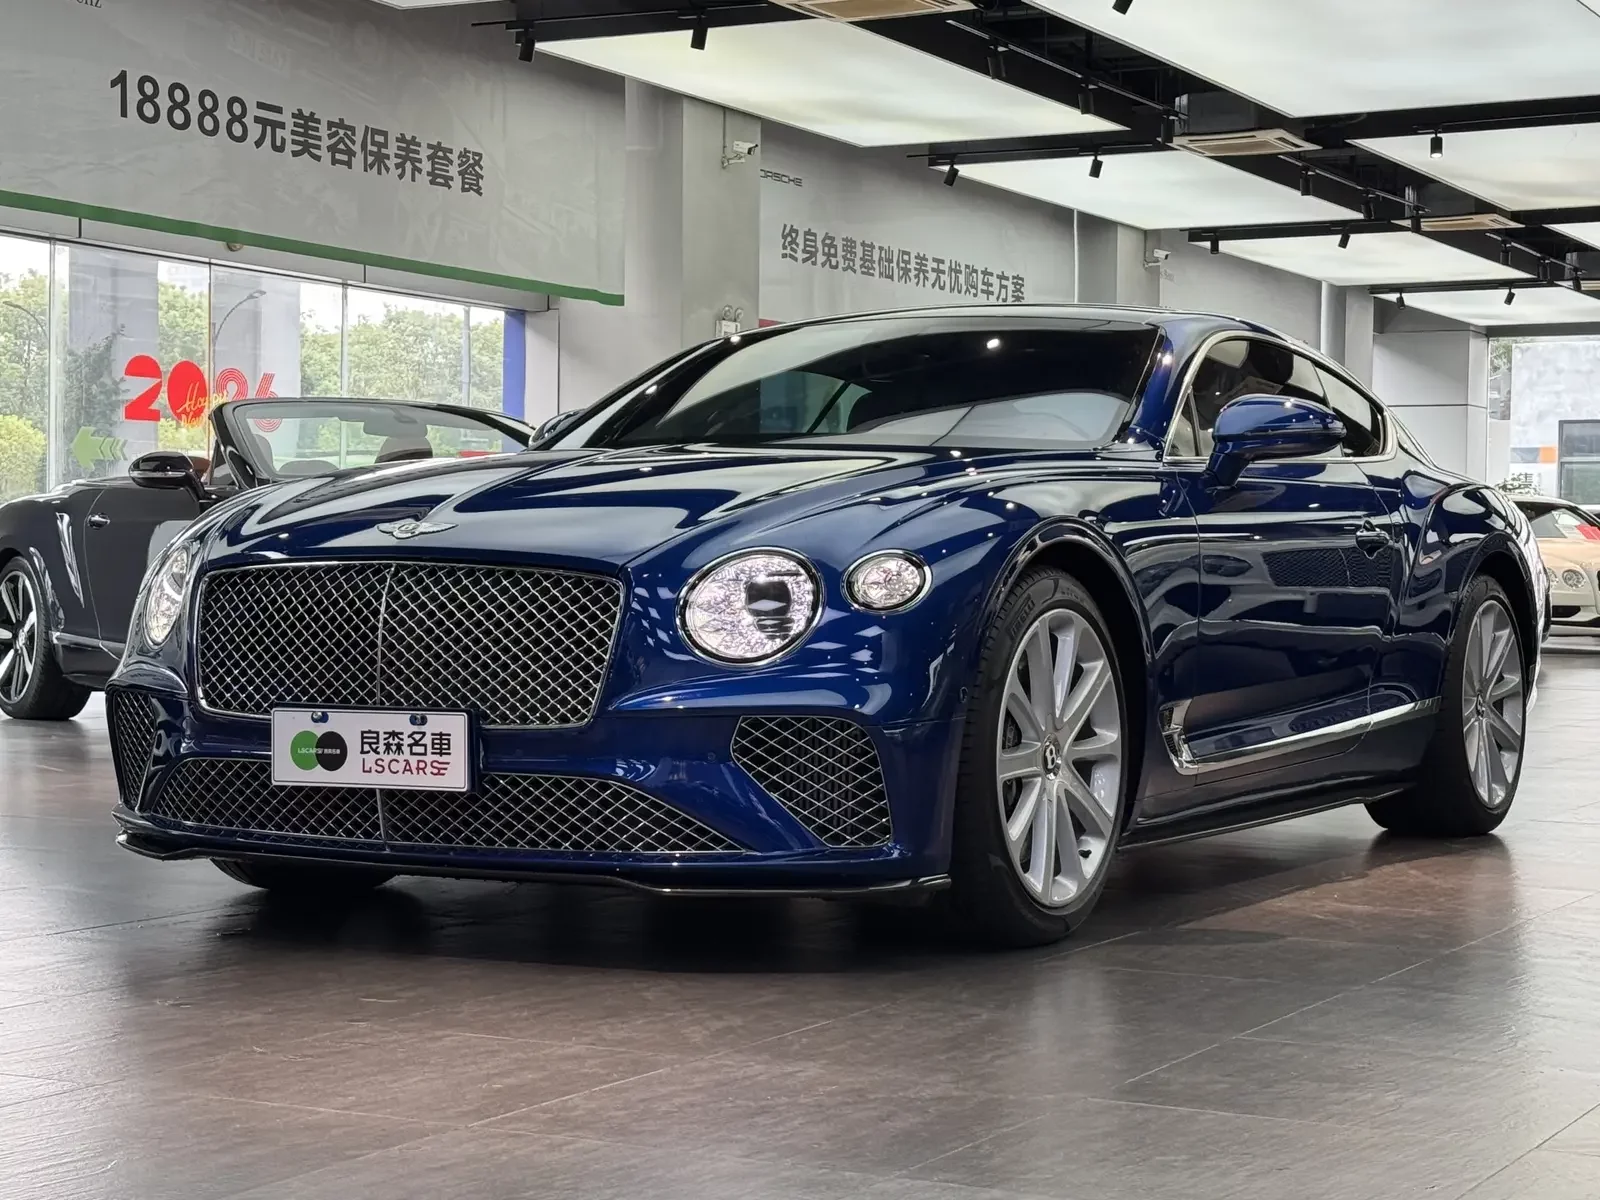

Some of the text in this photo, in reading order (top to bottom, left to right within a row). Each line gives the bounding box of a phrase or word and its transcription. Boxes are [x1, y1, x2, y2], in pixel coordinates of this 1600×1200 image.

[109, 69, 485, 197] 18888元美容保养套餐
[780, 223, 1026, 303] 终身免费基础保养无忧购车方案
[359, 729, 452, 758] 良森名車
[361, 757, 451, 777] LSCARS
